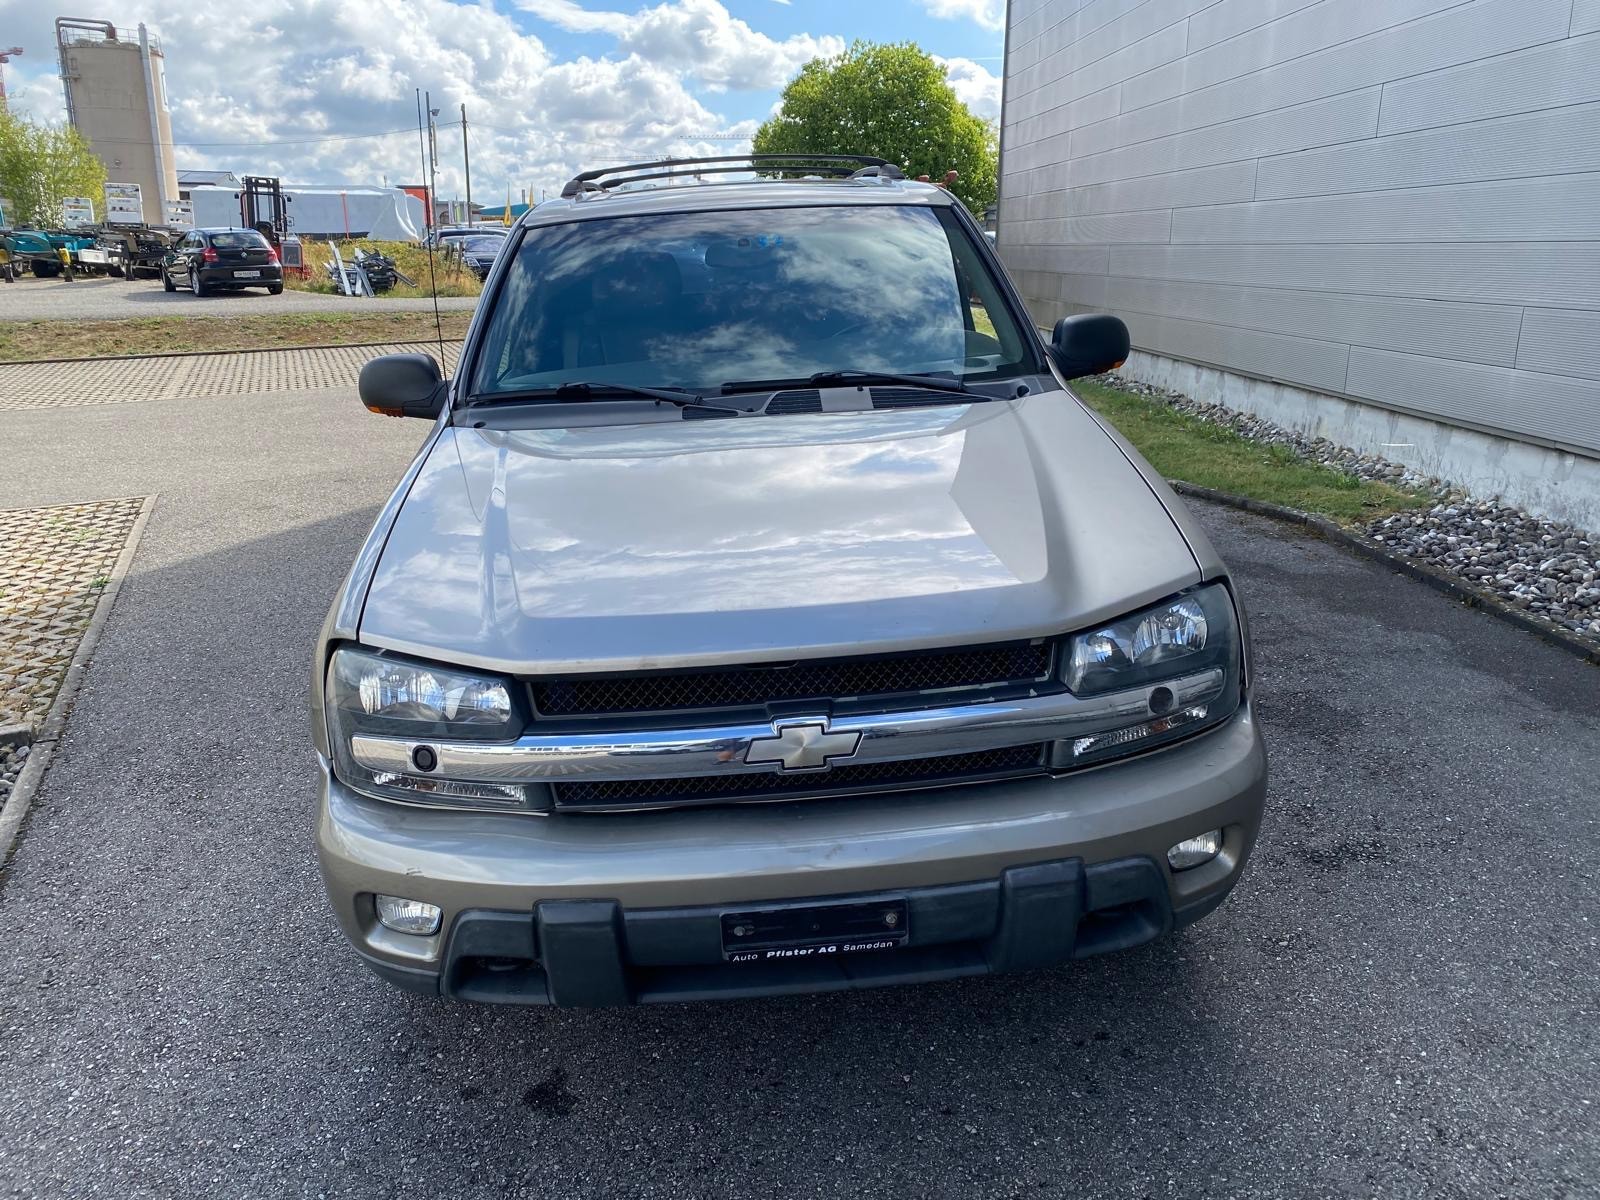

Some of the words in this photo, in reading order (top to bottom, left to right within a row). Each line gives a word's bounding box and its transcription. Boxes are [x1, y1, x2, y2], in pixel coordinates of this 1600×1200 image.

[732, 953, 758, 962] Auto
[766, 948, 814, 958] Pfister
[843, 941, 893, 951] Samedan
